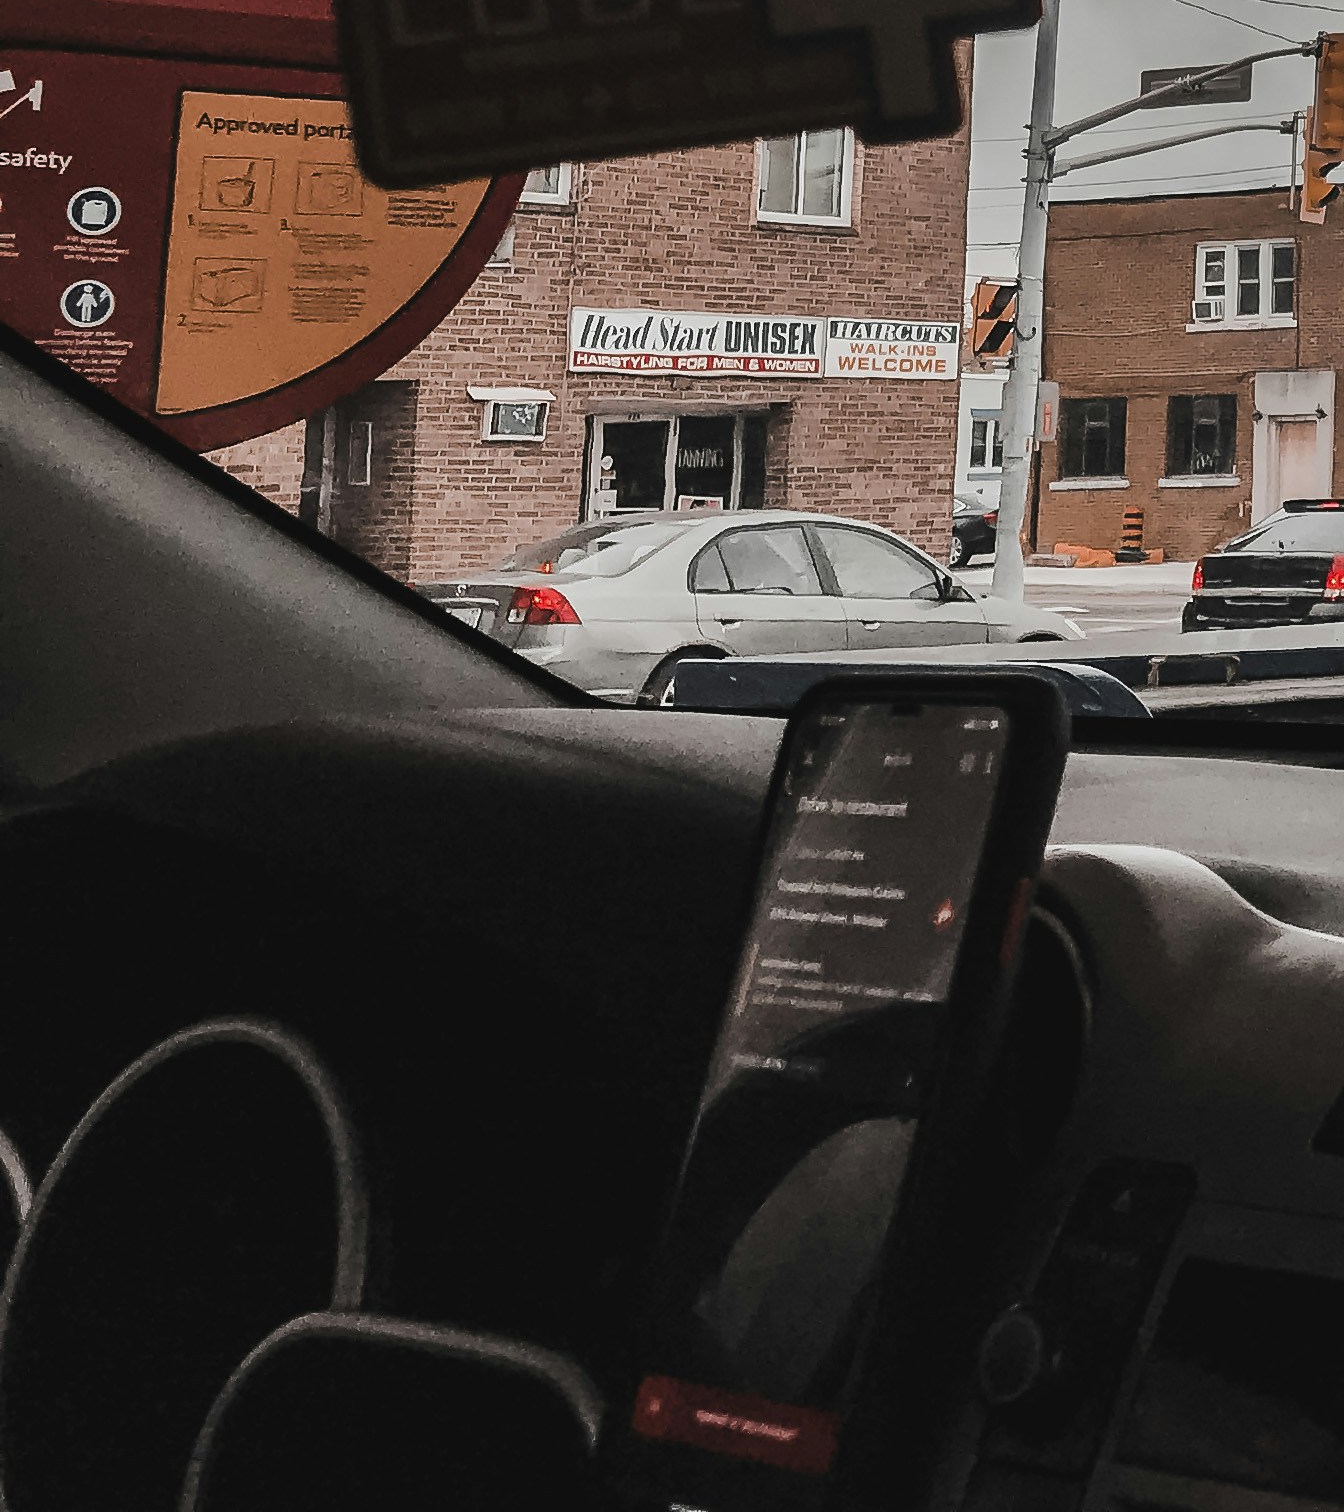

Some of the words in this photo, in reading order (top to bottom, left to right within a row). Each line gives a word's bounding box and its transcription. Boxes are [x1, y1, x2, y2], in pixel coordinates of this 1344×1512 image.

[197, 112, 299, 135] Approved
[0, 148, 72, 174] safety
[579, 314, 653, 350] Head
[652, 316, 720, 352] Start
[724, 320, 817, 355] UNISEX
[835, 321, 953, 343] HAIRCUTS
[576, 354, 673, 369] HAIRSTYLING
[678, 357, 707, 370] FOR
[713, 358, 744, 370] MEN
[749, 359, 760, 371] &
[764, 360, 816, 372] WOMEN
[838, 356, 947, 373] WELCOME
